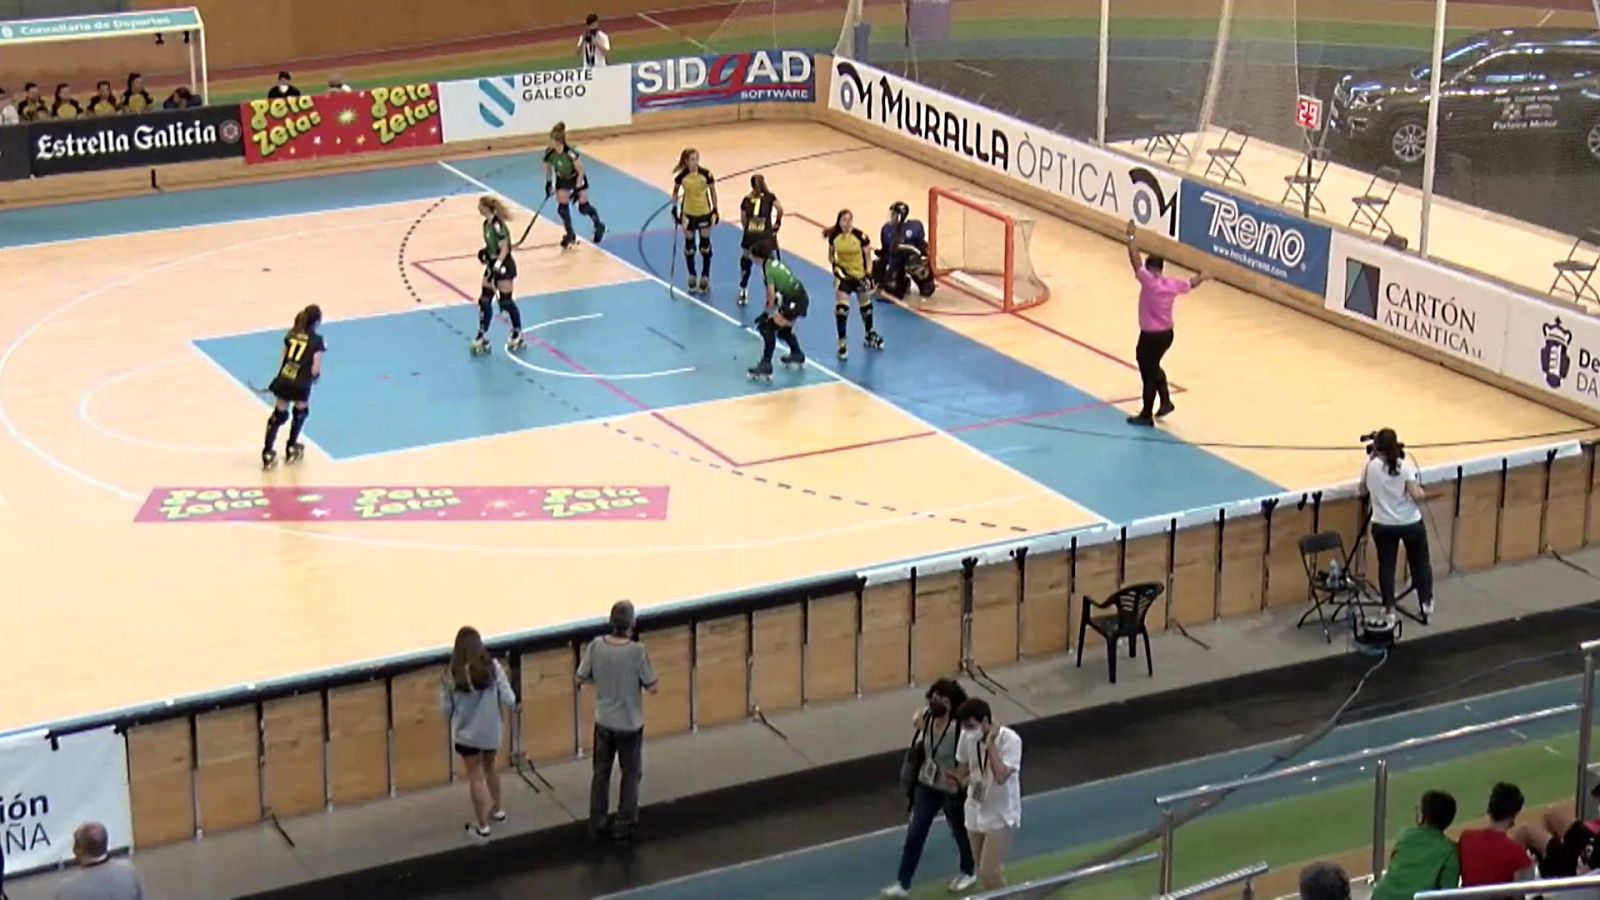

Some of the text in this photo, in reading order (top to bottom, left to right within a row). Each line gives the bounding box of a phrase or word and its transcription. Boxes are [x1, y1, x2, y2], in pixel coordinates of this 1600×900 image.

[522, 69, 593, 87] DEPORTE
[522, 84, 586, 101] GALEGO
[740, 89, 809, 100] SOFTWARE
[250, 95, 314, 130] Peta
[371, 83, 432, 118] Peta
[1299, 101, 1318, 125] 29
[36, 119, 217, 160] Estrella Galicia
[252, 111, 322, 156] Zetas
[1200, 191, 1305, 268] Reno
[1385, 282, 1476, 334] CARTÓN
[1576, 371, 1599, 398] DA
[5, 821, 51, 855] ÑA
